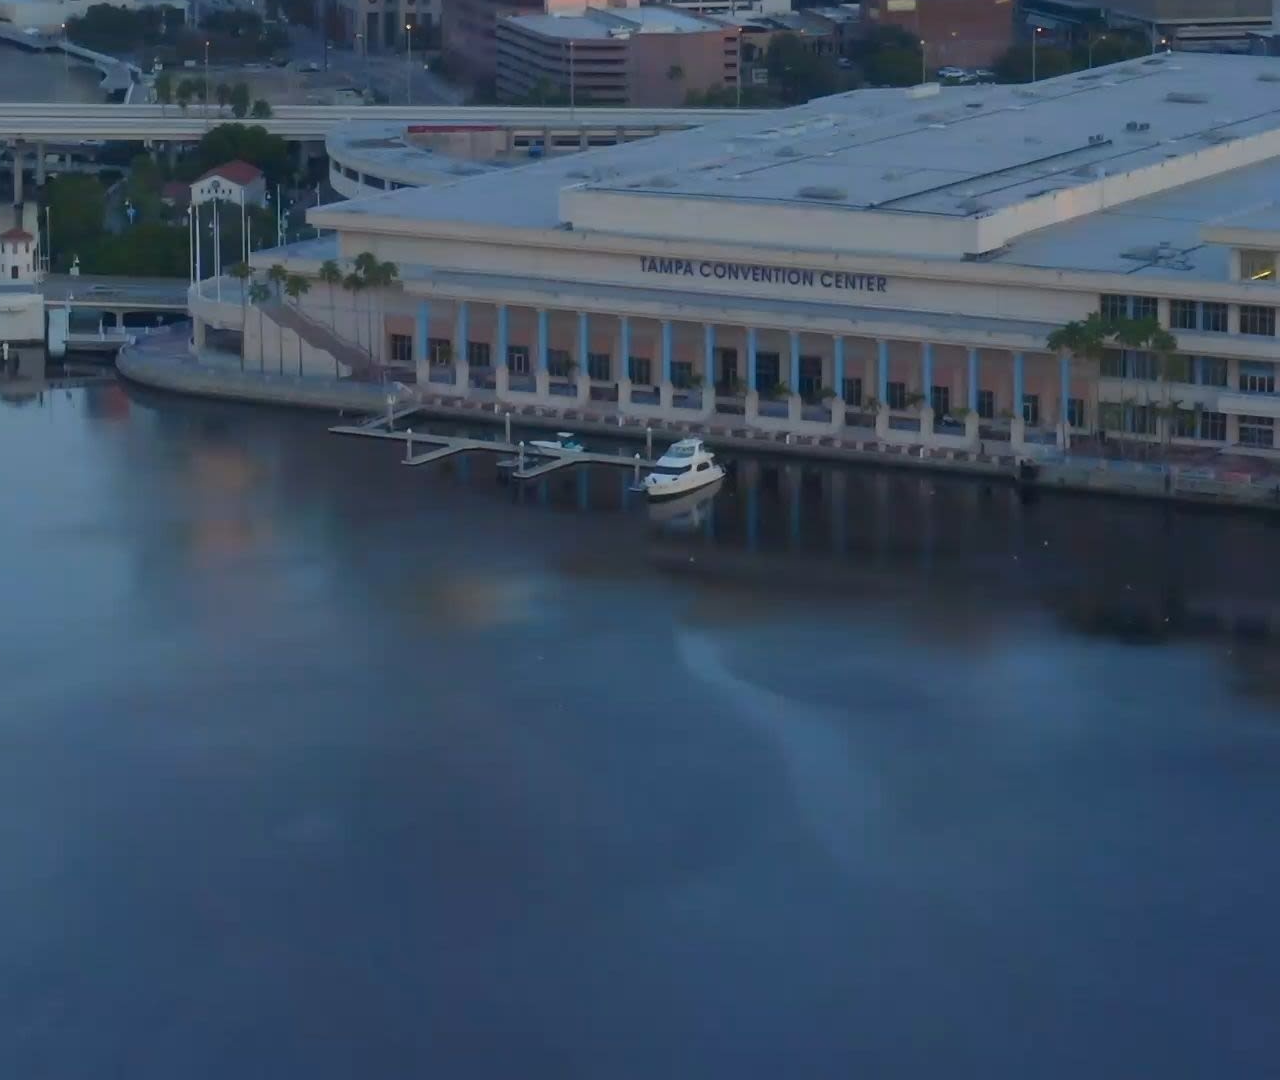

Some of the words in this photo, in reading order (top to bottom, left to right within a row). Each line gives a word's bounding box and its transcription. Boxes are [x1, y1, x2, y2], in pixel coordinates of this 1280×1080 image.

[640, 256, 695, 277] TAMPA
[699, 263, 814, 287] CONVENTION
[820, 271, 887, 293] CENTER
